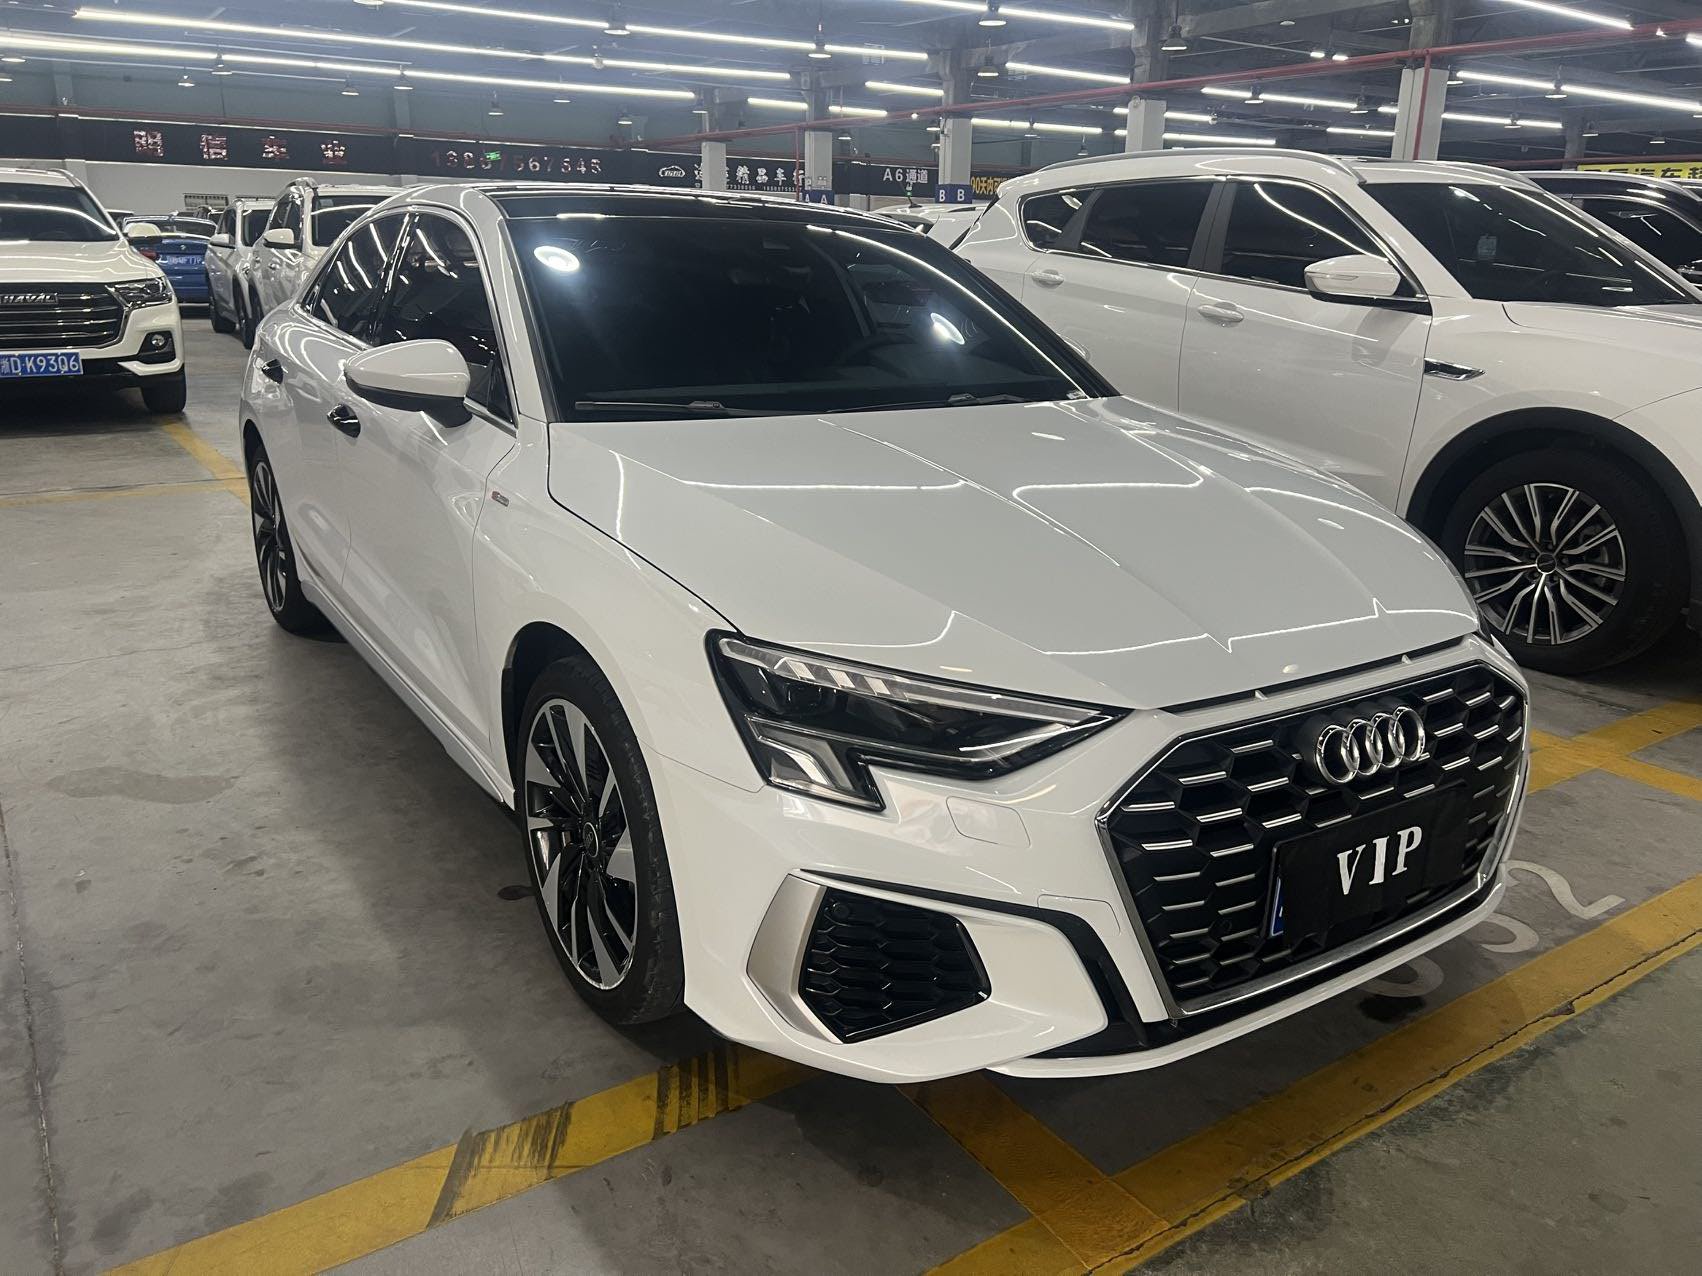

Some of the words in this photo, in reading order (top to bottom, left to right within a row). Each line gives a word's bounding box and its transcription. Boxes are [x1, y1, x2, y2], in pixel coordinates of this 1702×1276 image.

[883, 168, 928, 184] A6通道
[939, 189, 946, 202] B
[957, 189, 965, 201] B
[3, 293, 56, 303] HAVAL
[1336, 826, 1423, 896] VIP
